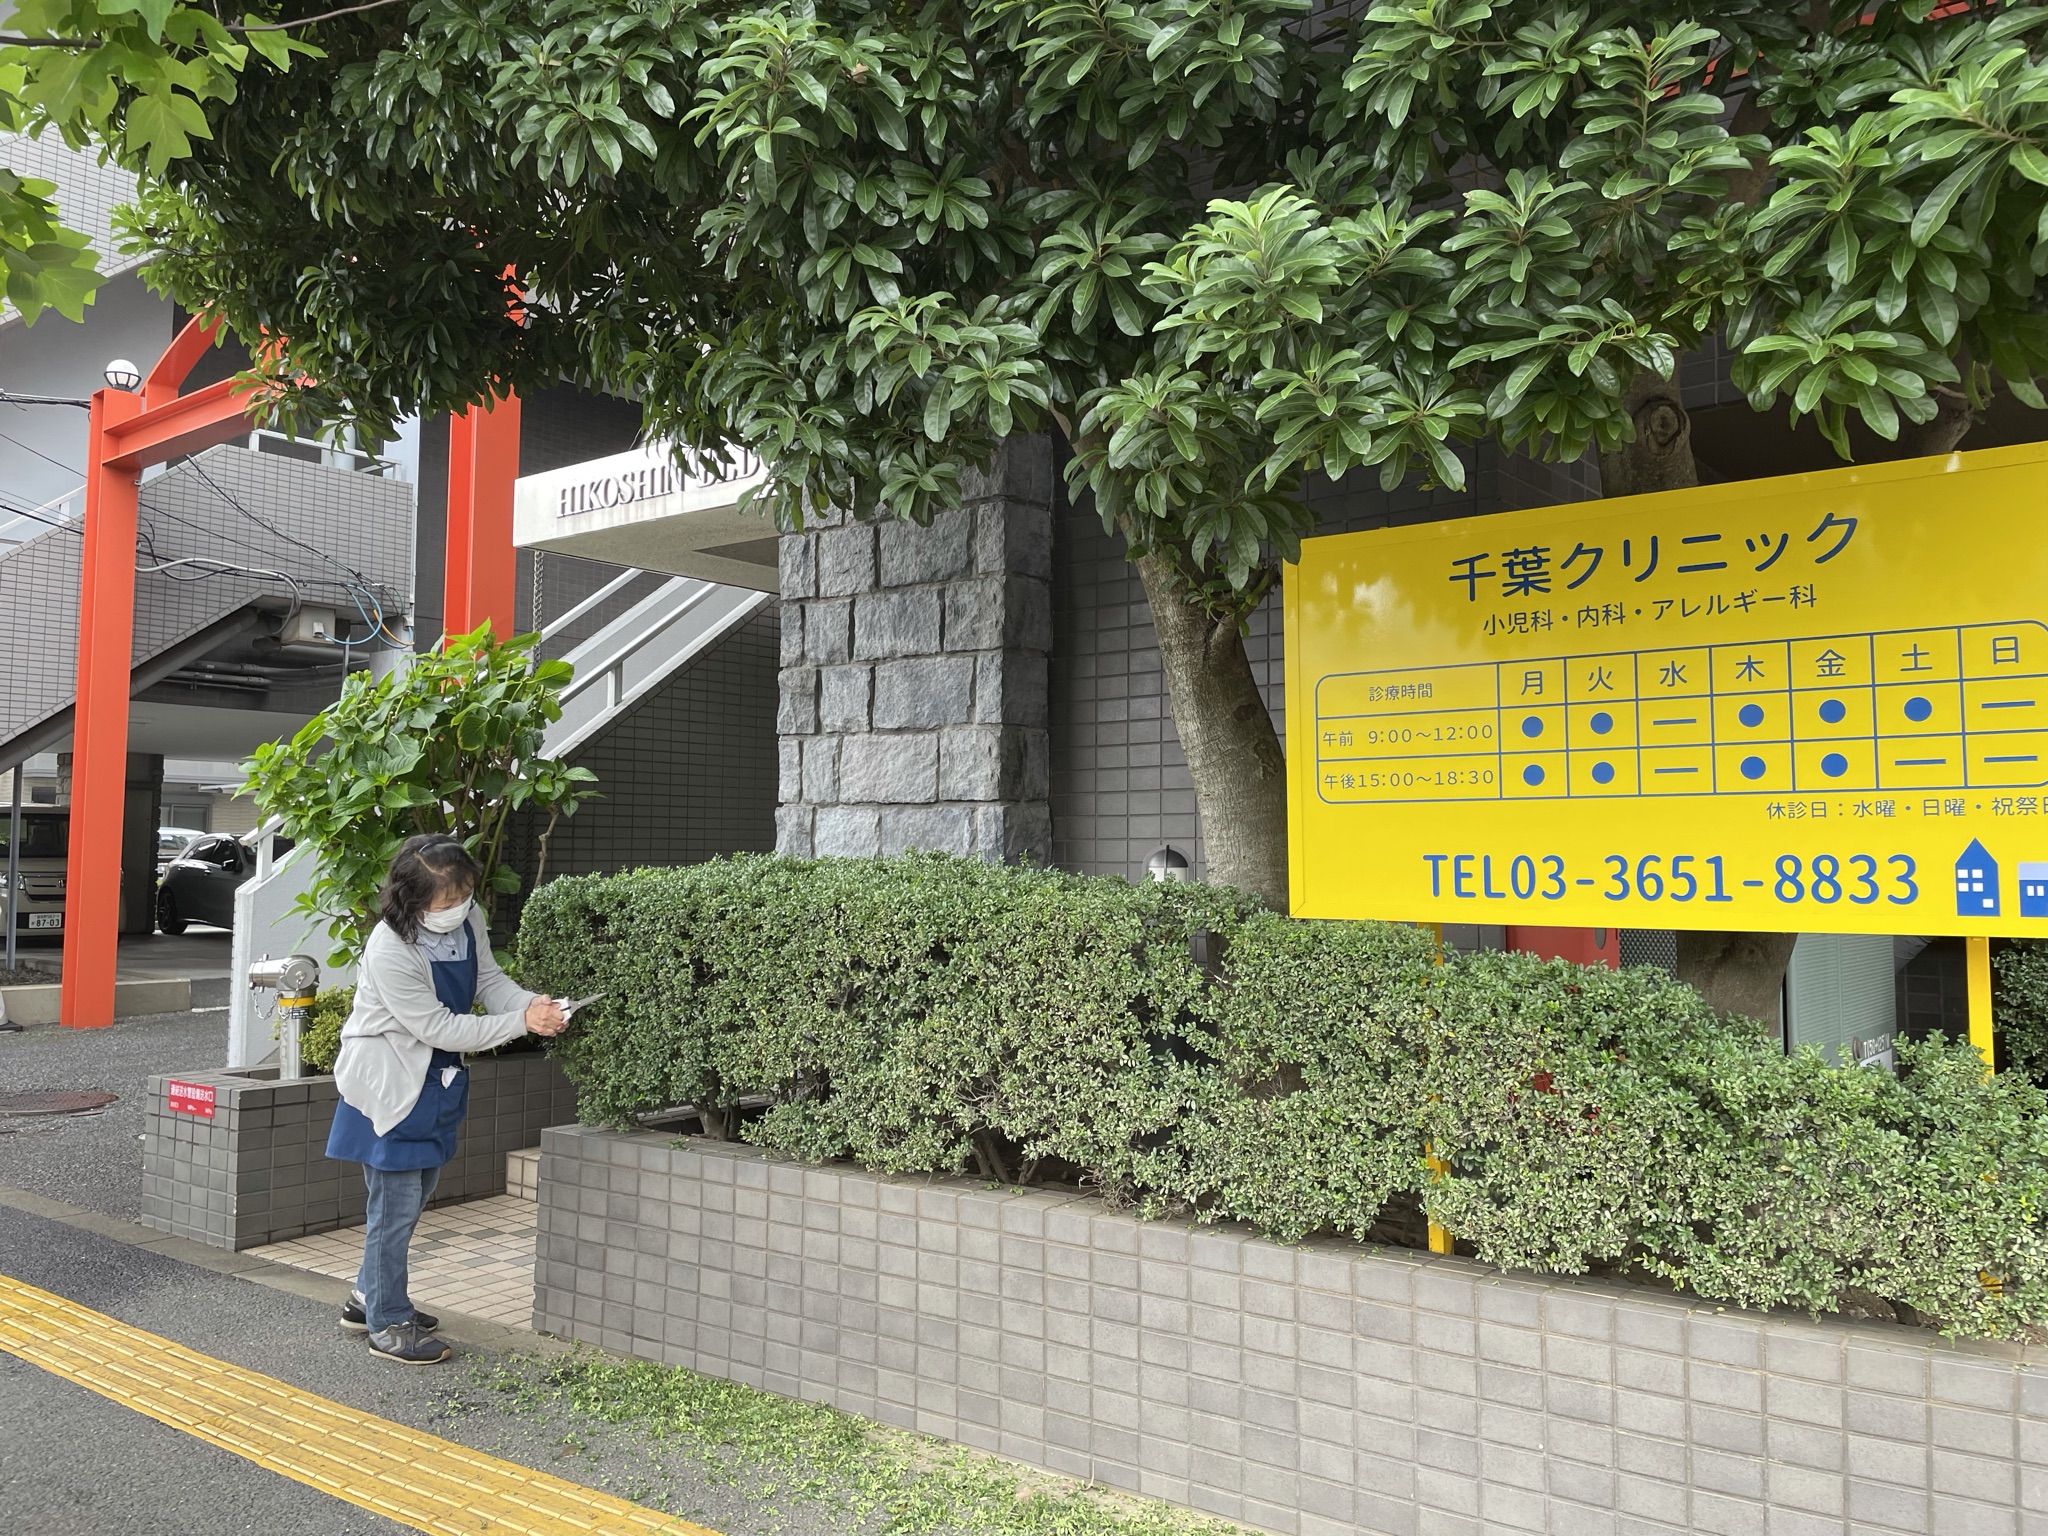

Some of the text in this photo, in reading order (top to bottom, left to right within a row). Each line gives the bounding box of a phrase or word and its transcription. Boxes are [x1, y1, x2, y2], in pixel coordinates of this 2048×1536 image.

[1449, 512, 1858, 602] 千葉クリニック
[1482, 583, 1818, 636] 小児科・内科・アレルギー科
[1368, 636, 2020, 702] 診療時間 月 火 水 木 金 土 日
[1322, 731, 1354, 747] 午前
[1422, 853, 1920, 905] TEL03-3651-8833
